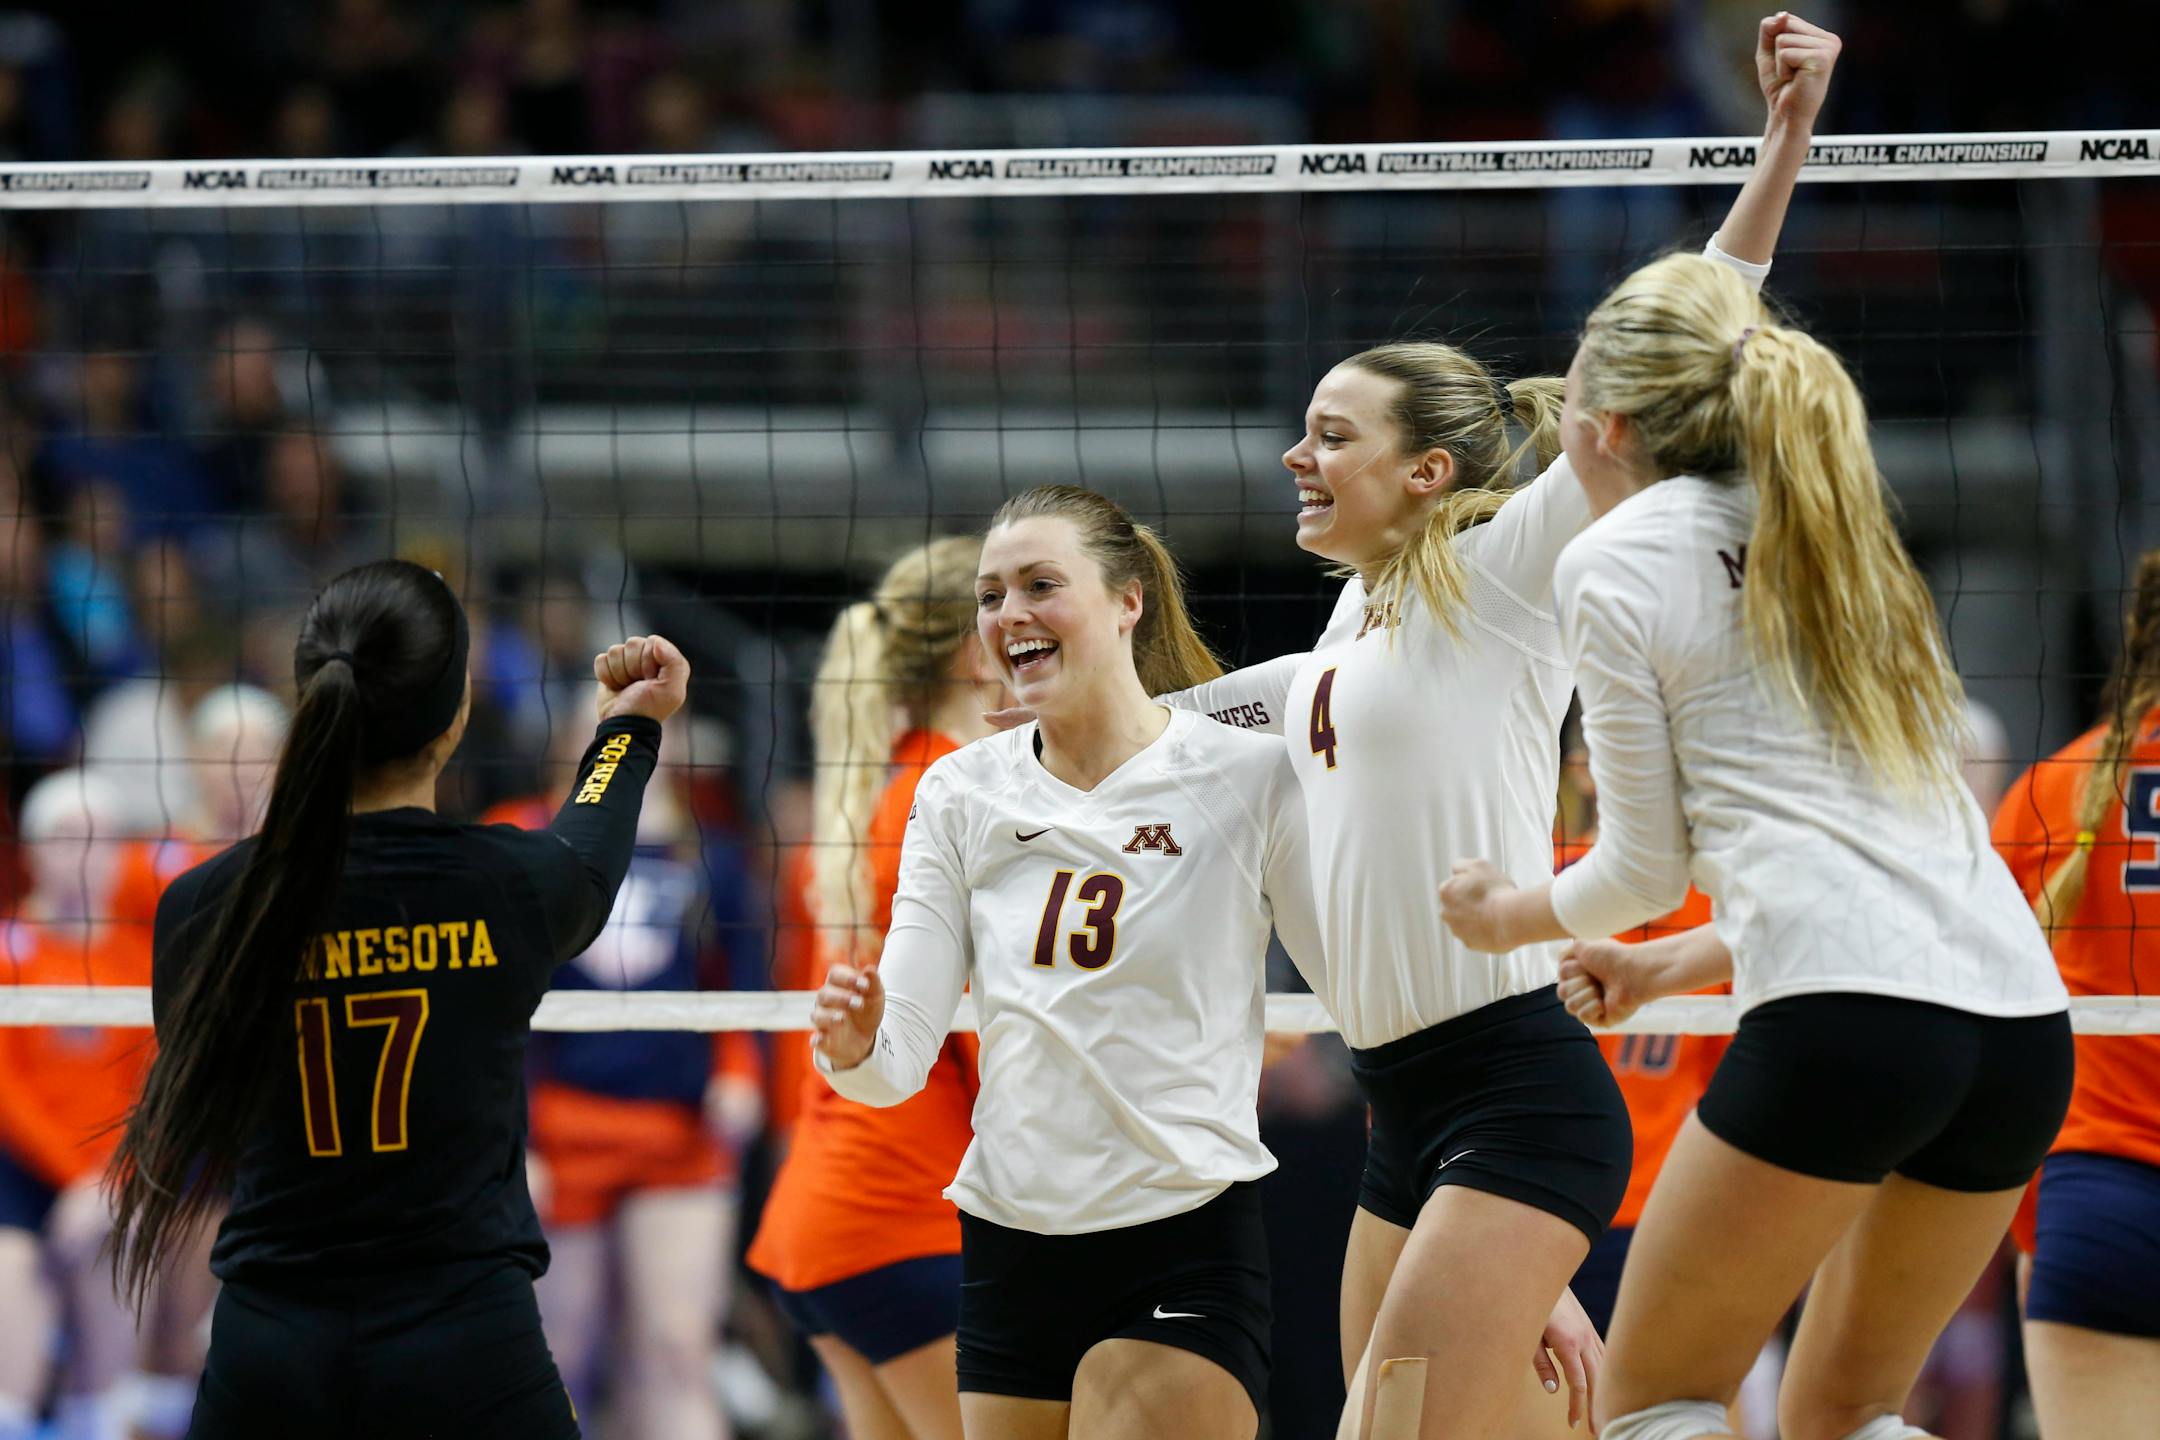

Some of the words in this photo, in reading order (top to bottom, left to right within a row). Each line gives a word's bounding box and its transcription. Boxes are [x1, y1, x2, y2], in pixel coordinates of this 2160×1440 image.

[1300, 154, 1366, 174] NCAA
[1379, 152, 1496, 173] VOLLEYBALL
[1502, 149, 1652, 170] CHAMPIONSHIP
[1689, 147, 1756, 168] NCAA
[1806, 145, 1888, 165] LEYBALL
[1894, 142, 2047, 163] CHAMPIONSHIP
[2080, 139, 2150, 161] NCAA
[183, 170, 248, 189] NCAA
[551, 166, 616, 185] NCAA
[928, 160, 993, 179] NCAA
[1128, 156, 1275, 176] CHAMPIONSHIP
[1206, 701, 1271, 728] HERS
[1308, 665, 1338, 772] 4
[1122, 824, 1183, 856] M
[1032, 868, 1126, 972] 13
[295, 987, 430, 1157] 17
